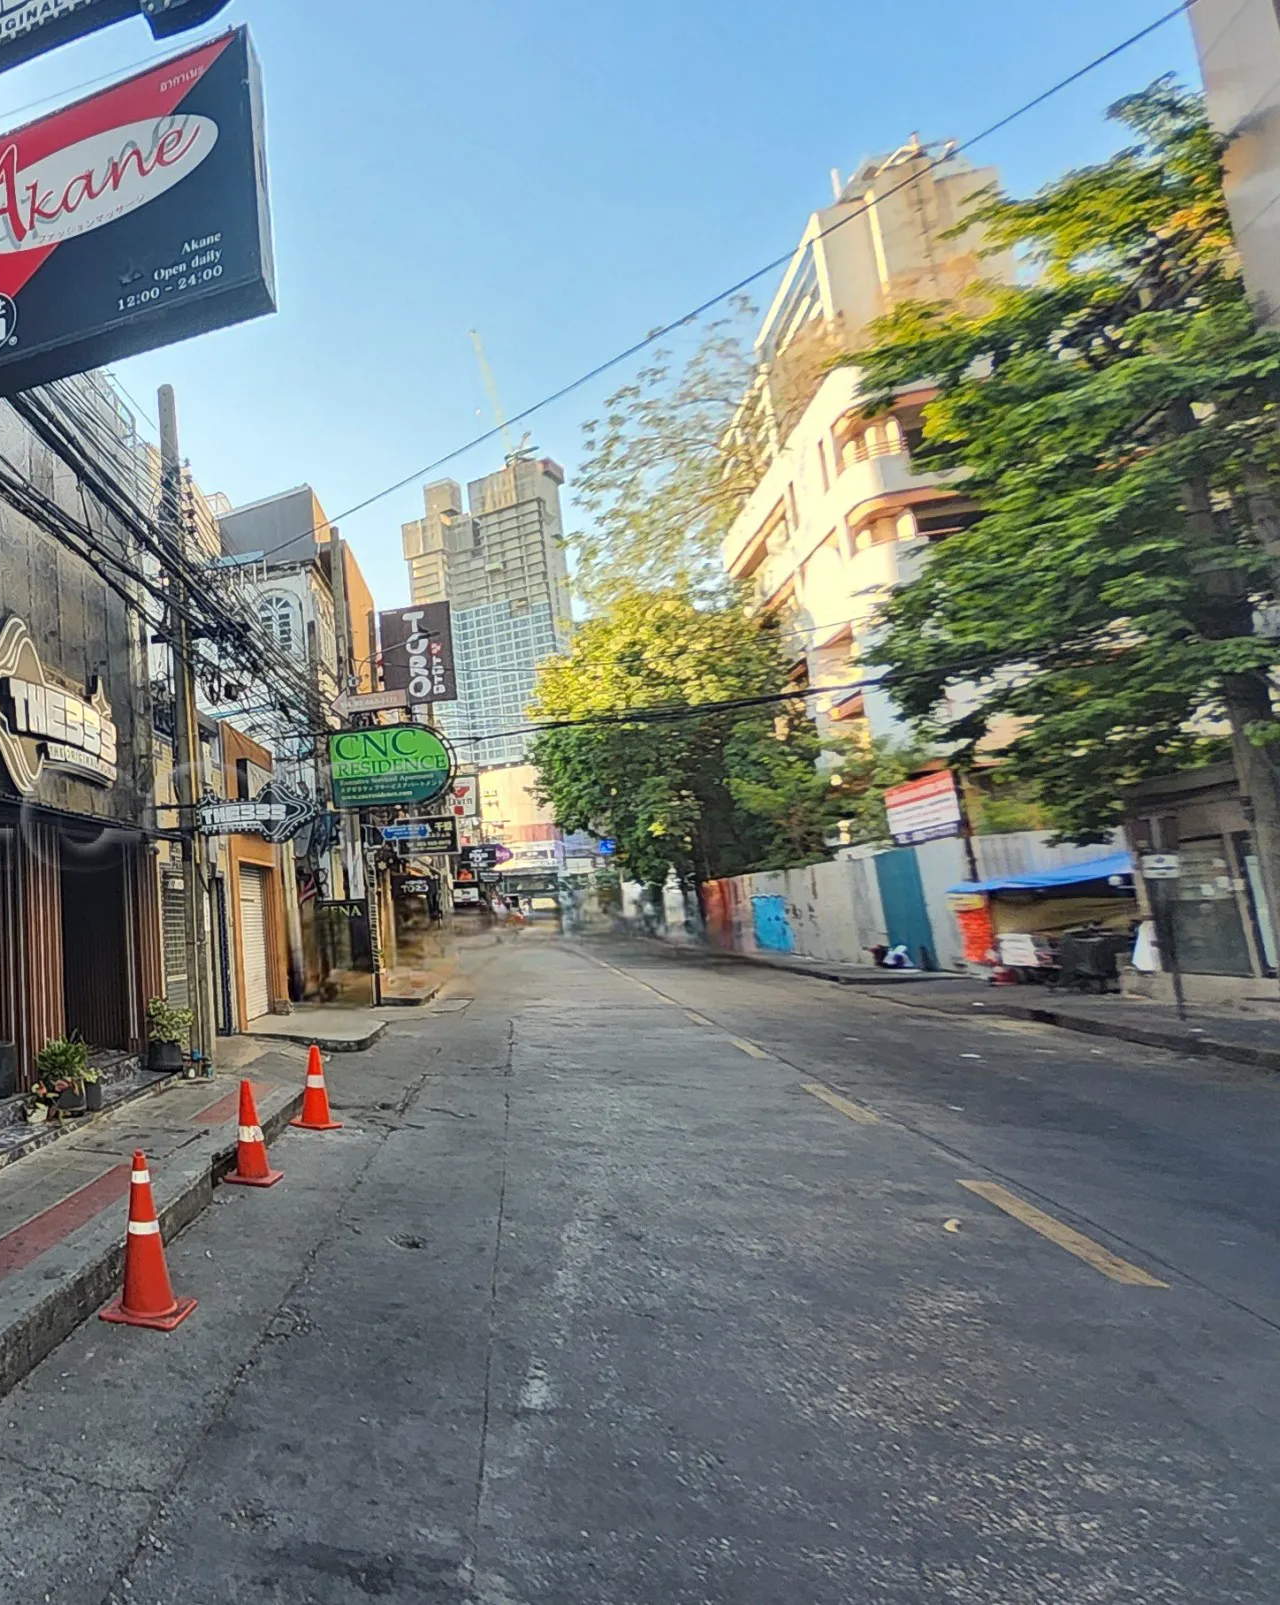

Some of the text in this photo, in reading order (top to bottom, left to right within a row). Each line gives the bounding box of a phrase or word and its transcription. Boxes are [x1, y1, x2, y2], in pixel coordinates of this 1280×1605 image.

[181, 232, 222, 255] Akane
[153, 248, 223, 281] Open daily
[118, 287, 160, 311] 12:00
[178, 265, 223, 290] 24:00
[402, 610, 432, 698] TORO
[49, 745, 65, 759] THE
[335, 729, 418, 761] CNC
[337, 754, 448, 777] RESIDENCE
